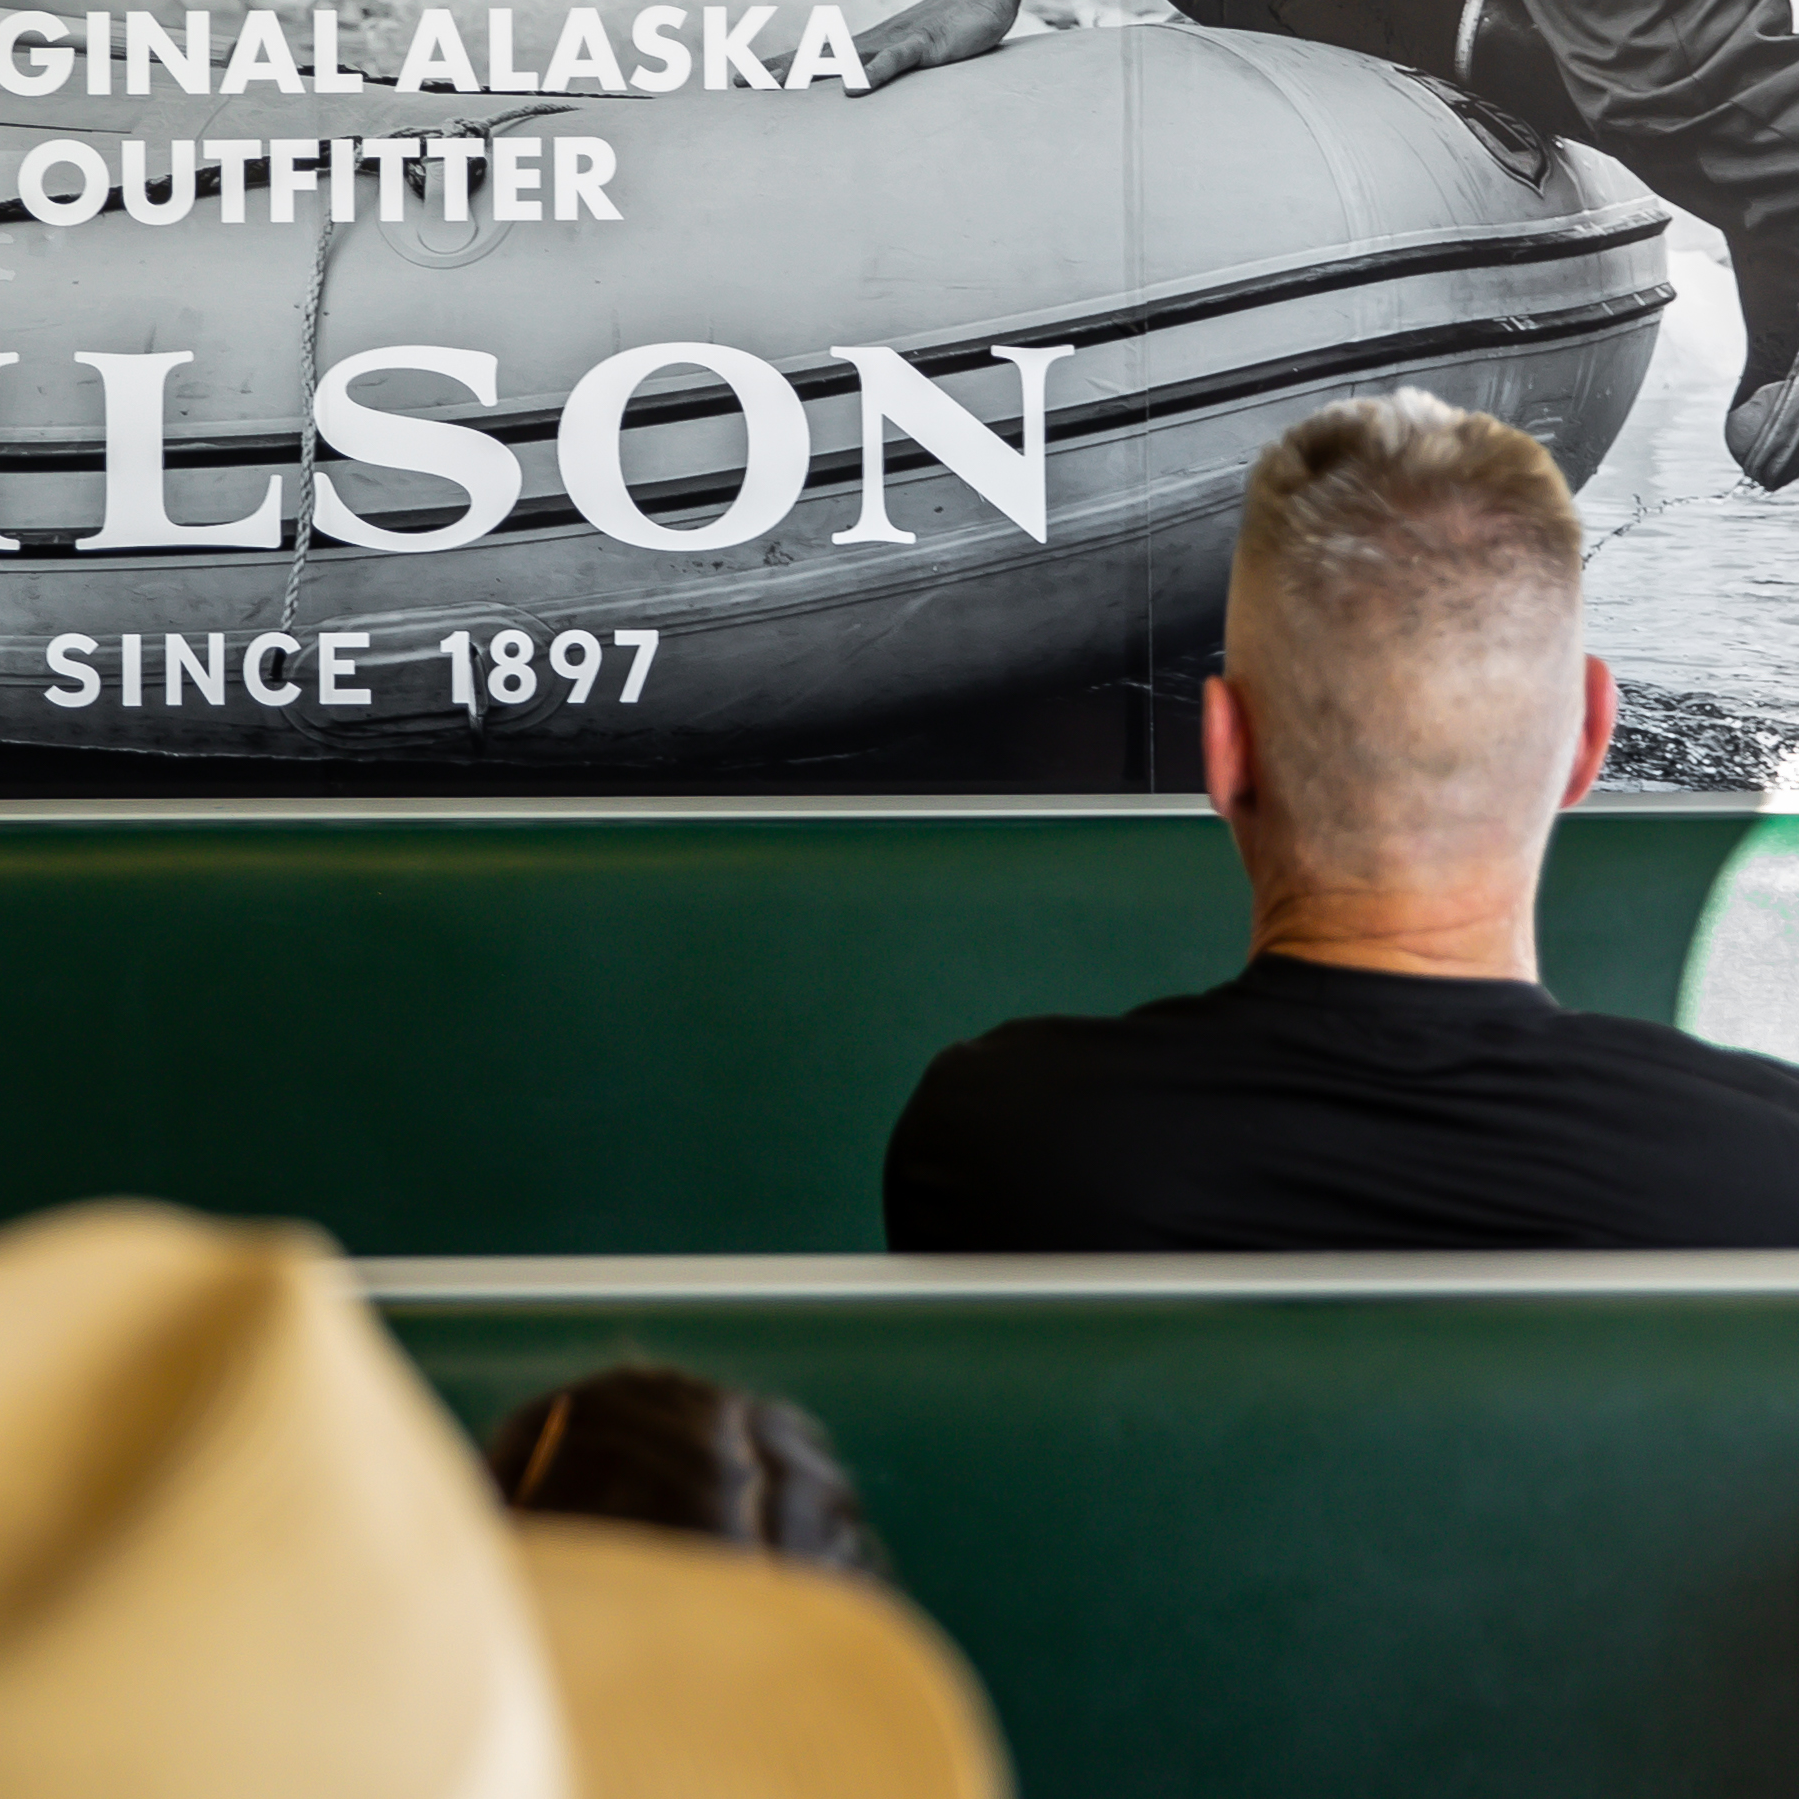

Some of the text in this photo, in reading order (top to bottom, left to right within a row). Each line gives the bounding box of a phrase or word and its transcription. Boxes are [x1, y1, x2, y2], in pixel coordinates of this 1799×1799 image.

[395, 5, 869, 93] ALASKA
[18, 136, 624, 226] OUTFITTER
[45, 629, 659, 707] SINCE 1897
